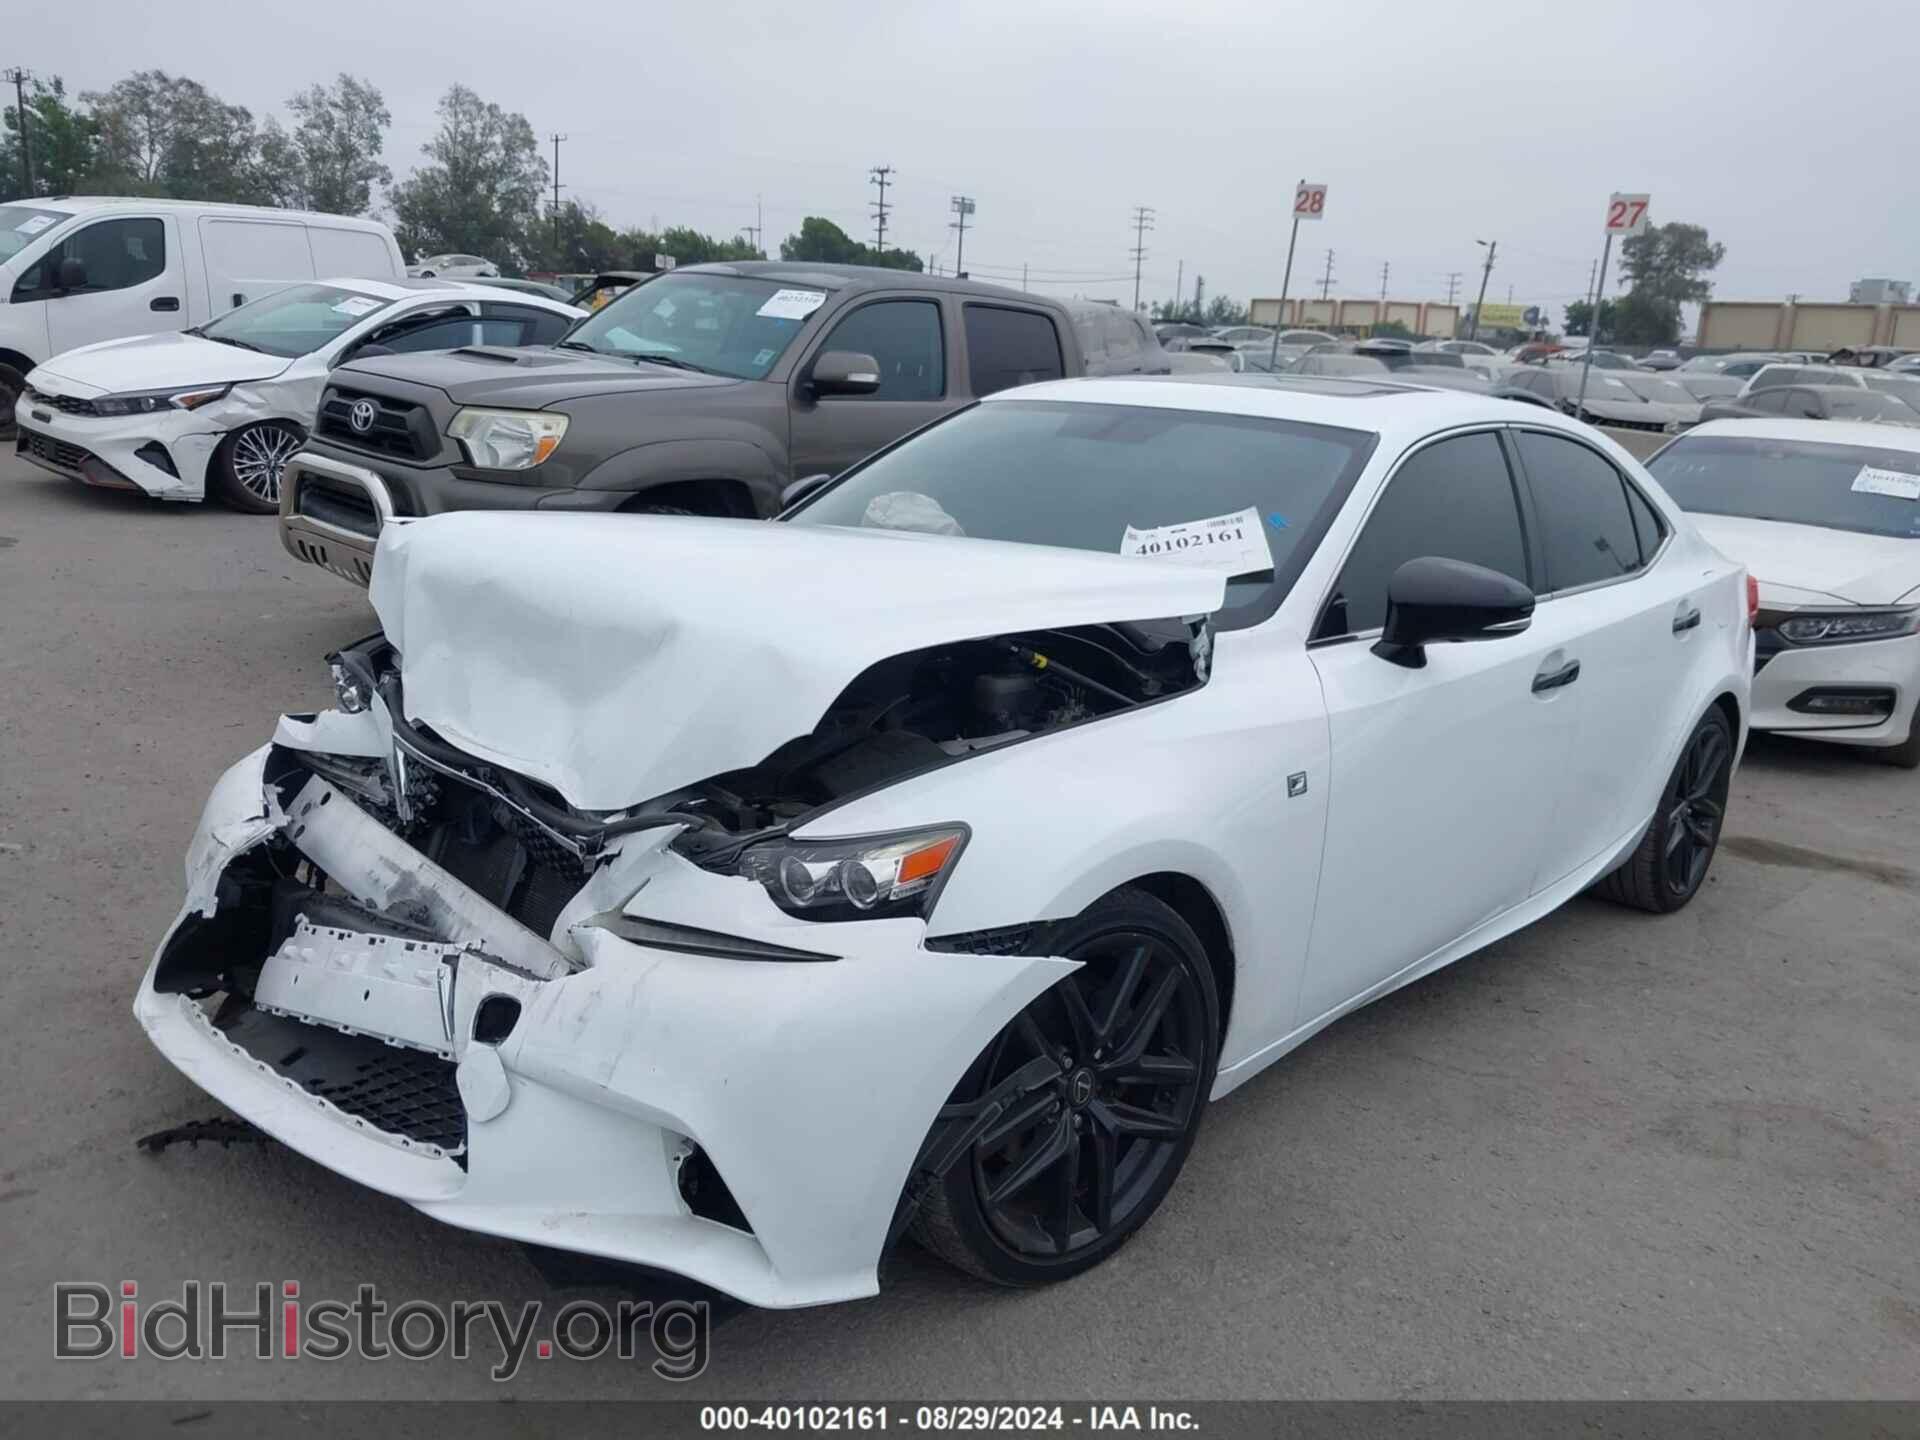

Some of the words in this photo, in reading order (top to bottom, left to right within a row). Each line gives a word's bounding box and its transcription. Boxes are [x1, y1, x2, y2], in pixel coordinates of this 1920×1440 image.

[1296, 190, 1325, 213] 28
[1607, 200, 1647, 228] 27
[1136, 527, 1244, 556] 40102161
